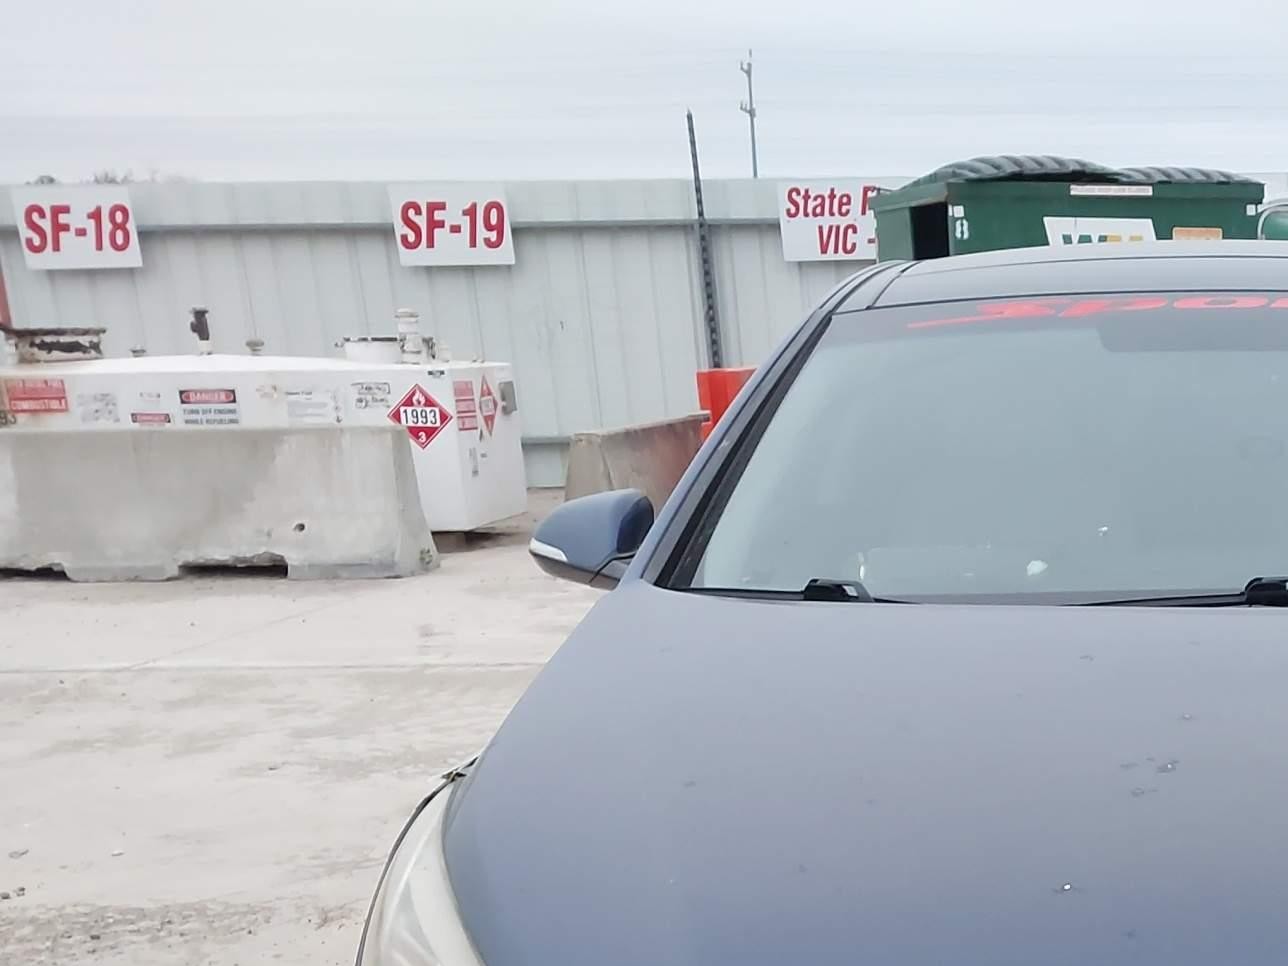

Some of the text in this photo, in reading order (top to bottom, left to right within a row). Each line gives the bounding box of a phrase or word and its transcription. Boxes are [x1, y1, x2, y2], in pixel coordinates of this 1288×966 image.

[786, 187, 851, 218] State
[24, 203, 131, 254] SF-18
[400, 201, 505, 250] SF-19
[817, 223, 858, 255] VIC
[402, 408, 438, 425] 1993
[418, 431, 428, 443] 3
